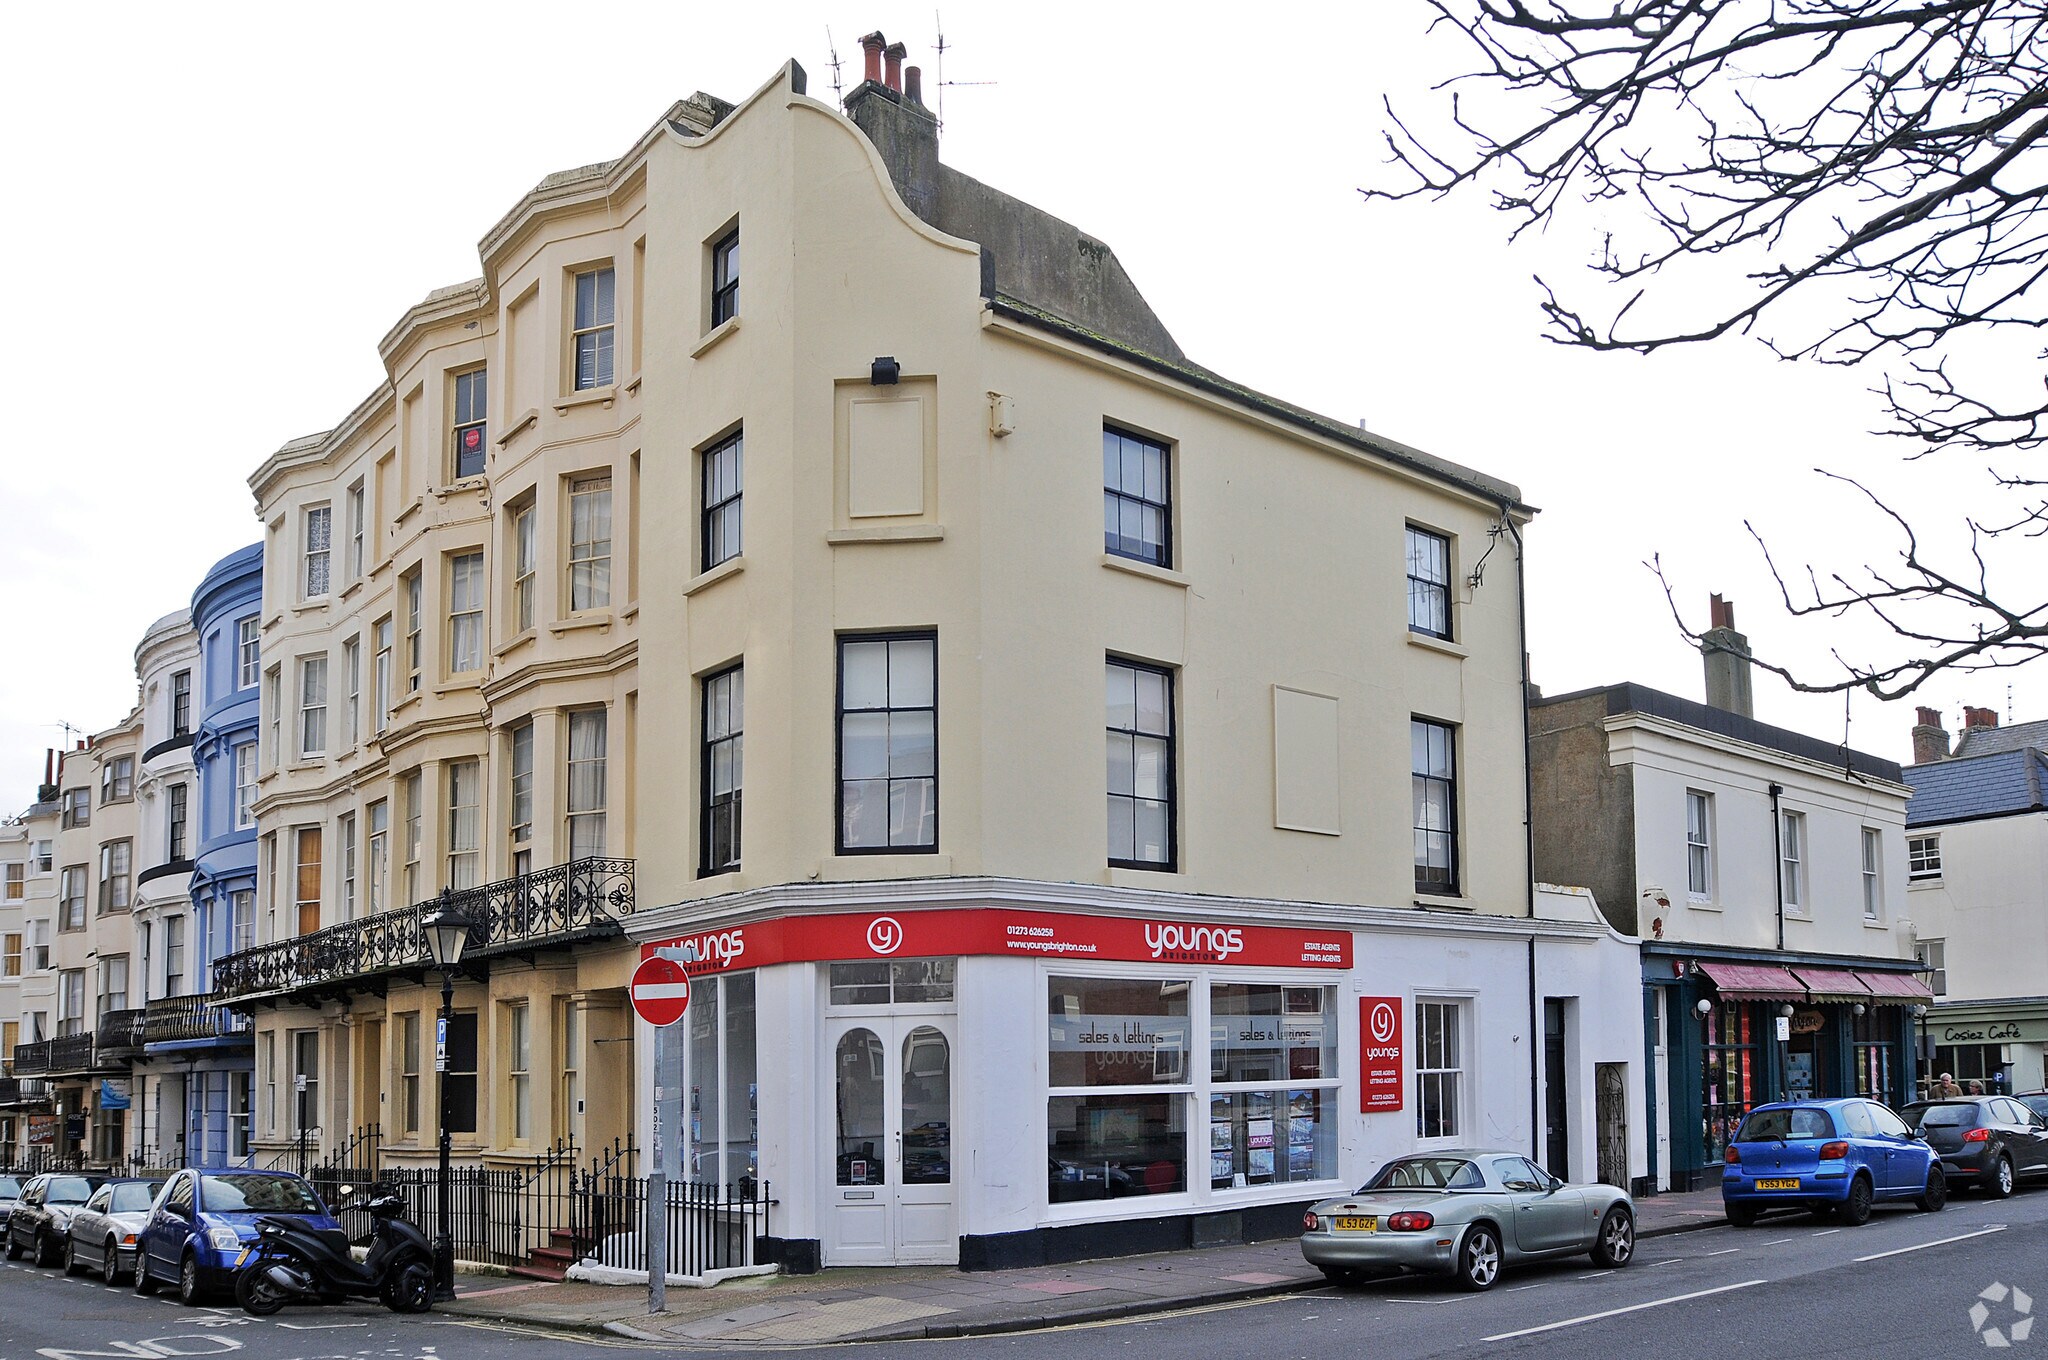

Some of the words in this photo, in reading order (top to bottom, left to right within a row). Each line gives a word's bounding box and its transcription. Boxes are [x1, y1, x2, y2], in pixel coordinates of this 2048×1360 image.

[1006, 925, 1029, 936] 01273
[1029, 927, 1054, 937] 626258
[1006, 940, 1097, 953] www.youngsbrighton.co.uk
[1144, 923, 1244, 961] youngs
[1304, 942, 1321, 951] ESTATE
[1321, 943, 1341, 952] AGENTS
[1162, 951, 1217, 961] BRIGHTON
[1301, 953, 1322, 962] LETTING
[1322, 954, 1342, 963] AGENTS
[1078, 1020, 1109, 1044] sales
[1112, 1033, 1120, 1044] &
[1239, 1020, 1265, 1041] sales
[1267, 1031, 1275, 1041] &
[1944, 1027, 1984, 1041] Cosiez
[1988, 1022, 2022, 1040] Café
[1366, 1047, 1400, 1061] youngs
[1249, 1136, 1273, 1146] youngs
[1336, 1218, 1357, 1228] NL53
[1358, 1218, 1375, 1228] GZF
